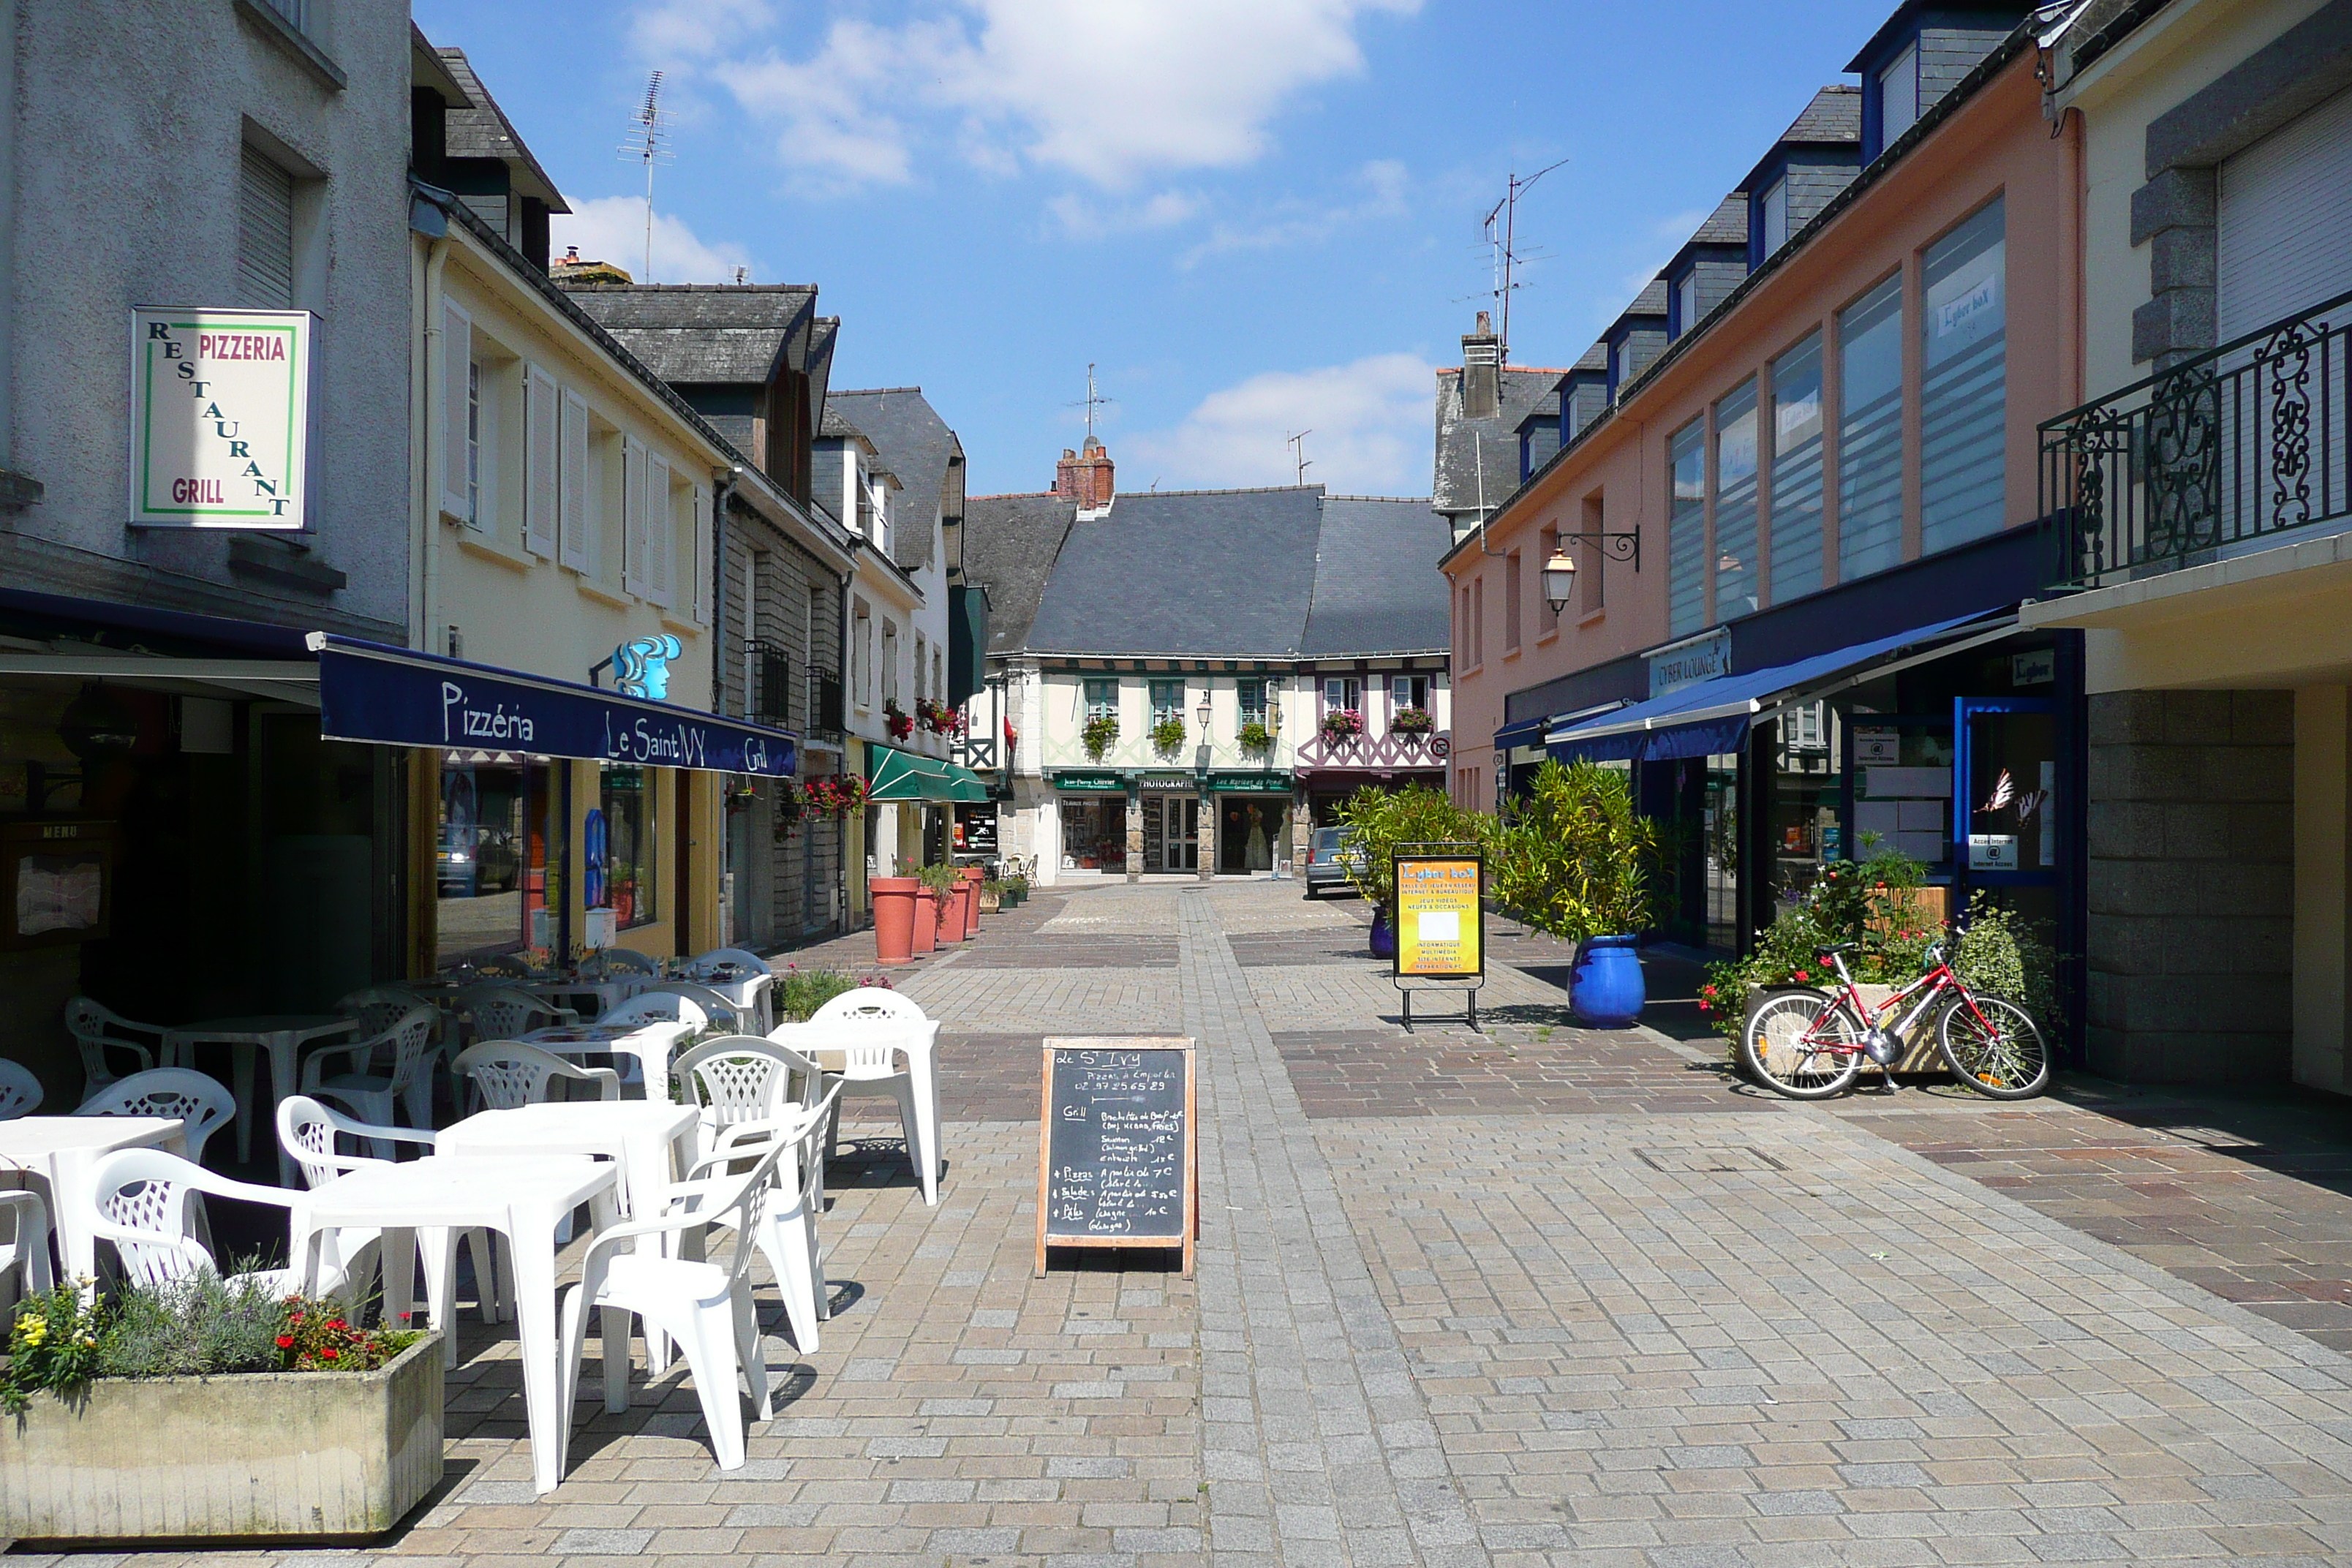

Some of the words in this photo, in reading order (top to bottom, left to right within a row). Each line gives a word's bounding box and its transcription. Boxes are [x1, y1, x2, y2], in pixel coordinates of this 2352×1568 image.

[200, 334, 285, 361] PIZZERIA
[147, 322, 290, 516] RESTAURANT
[172, 478, 224, 503] GRILL
[1659, 661, 1682, 686] CYBER
[1684, 653, 1717, 679] LOUNGE
[441, 681, 534, 743] Pizzéria
[606, 710, 629, 758] Le
[634, 717, 679, 761] Saint
[745, 737, 768, 772] Grill
[1139, 779, 1194, 788] PHOTOGRAPHE
[43, 826, 77, 838] MENU
[1986, 845, 2001, 860] @
[1056, 1051, 1074, 1063] Le
[1075, 1082, 1089, 1090] 02
[1130, 1082, 1147, 1090] 65
[1149, 1082, 1165, 1090] 29
[1063, 1106, 1086, 1117] Grill
